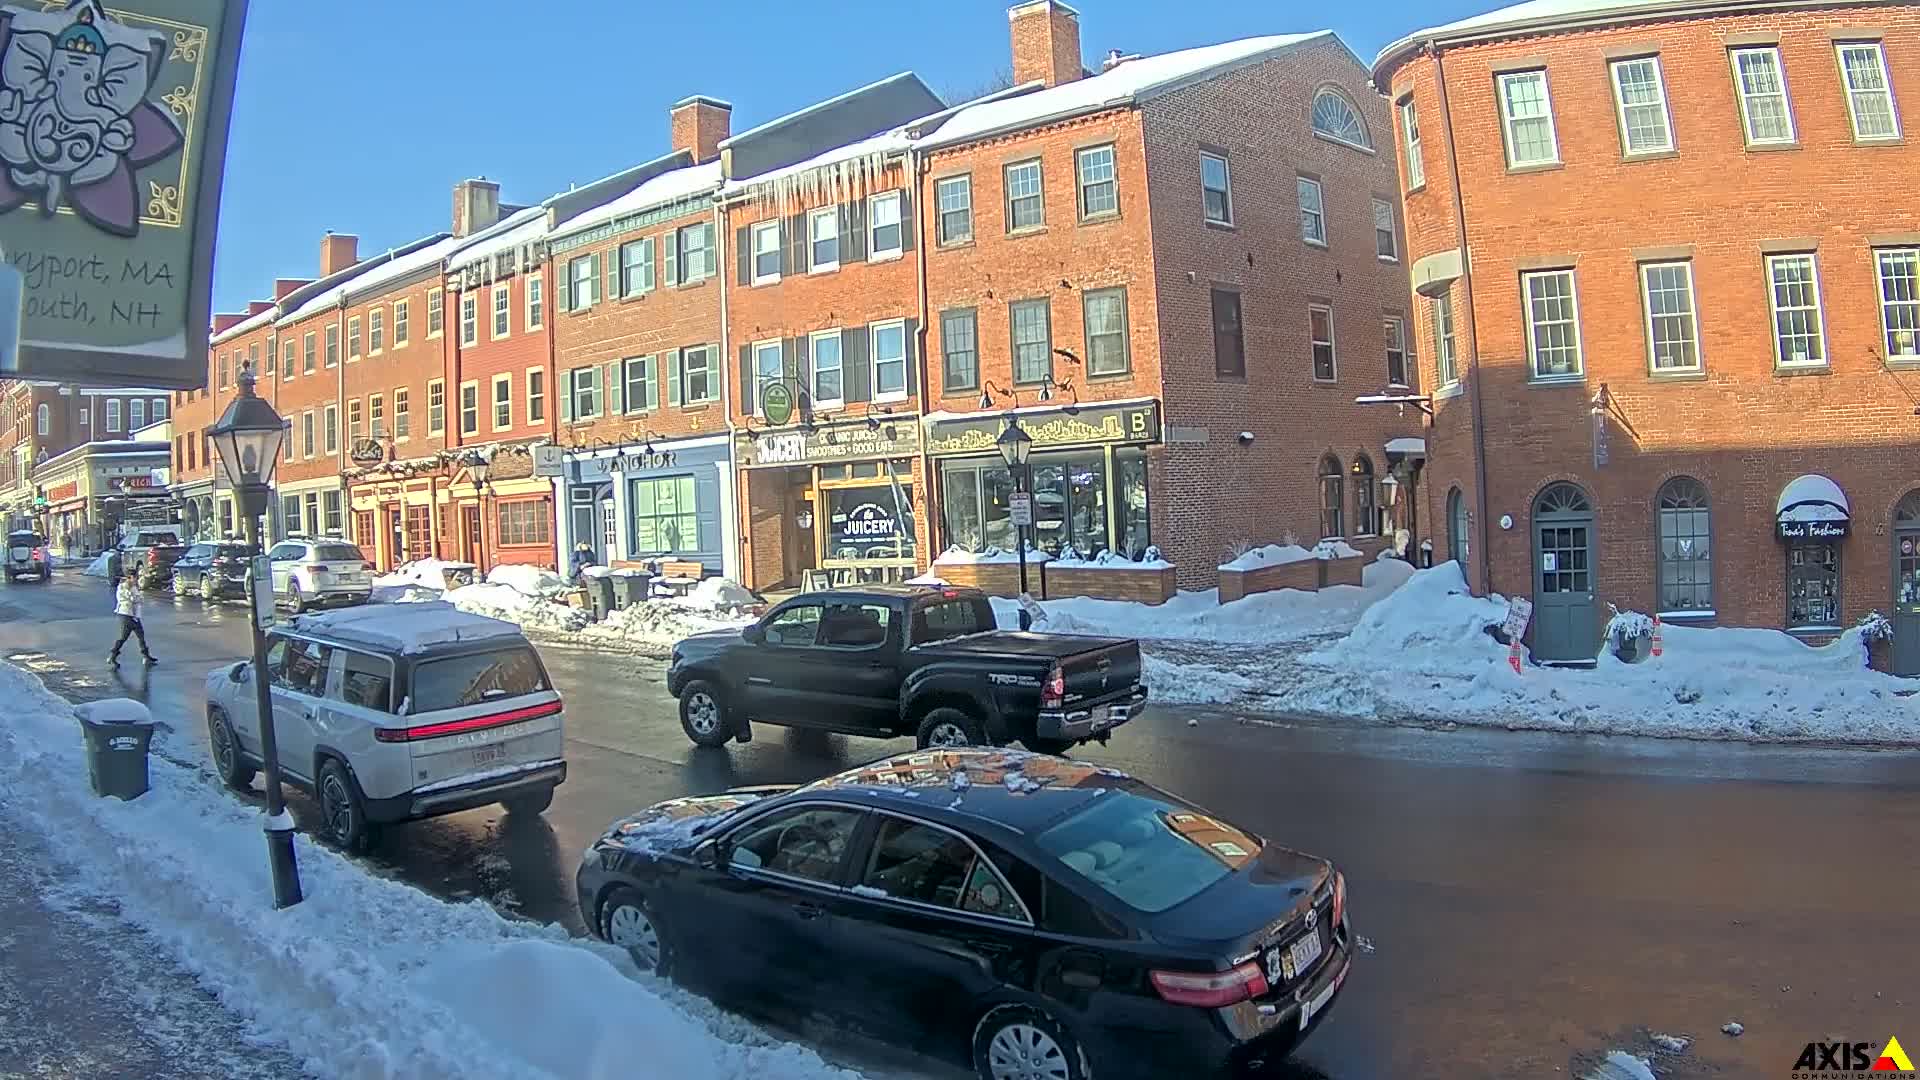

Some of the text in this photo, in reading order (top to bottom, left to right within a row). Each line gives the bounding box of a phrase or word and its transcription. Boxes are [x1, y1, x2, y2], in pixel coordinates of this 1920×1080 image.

[120, 259, 174, 289] MA
[111, 300, 161, 328] NH
[853, 442, 875, 454] GOOD
[875, 439, 894, 452] EATS
[610, 452, 677, 473] ANCHOR
[843, 519, 895, 535] JUICERY
[1780, 521, 1845, 537] Tina's Fashions
